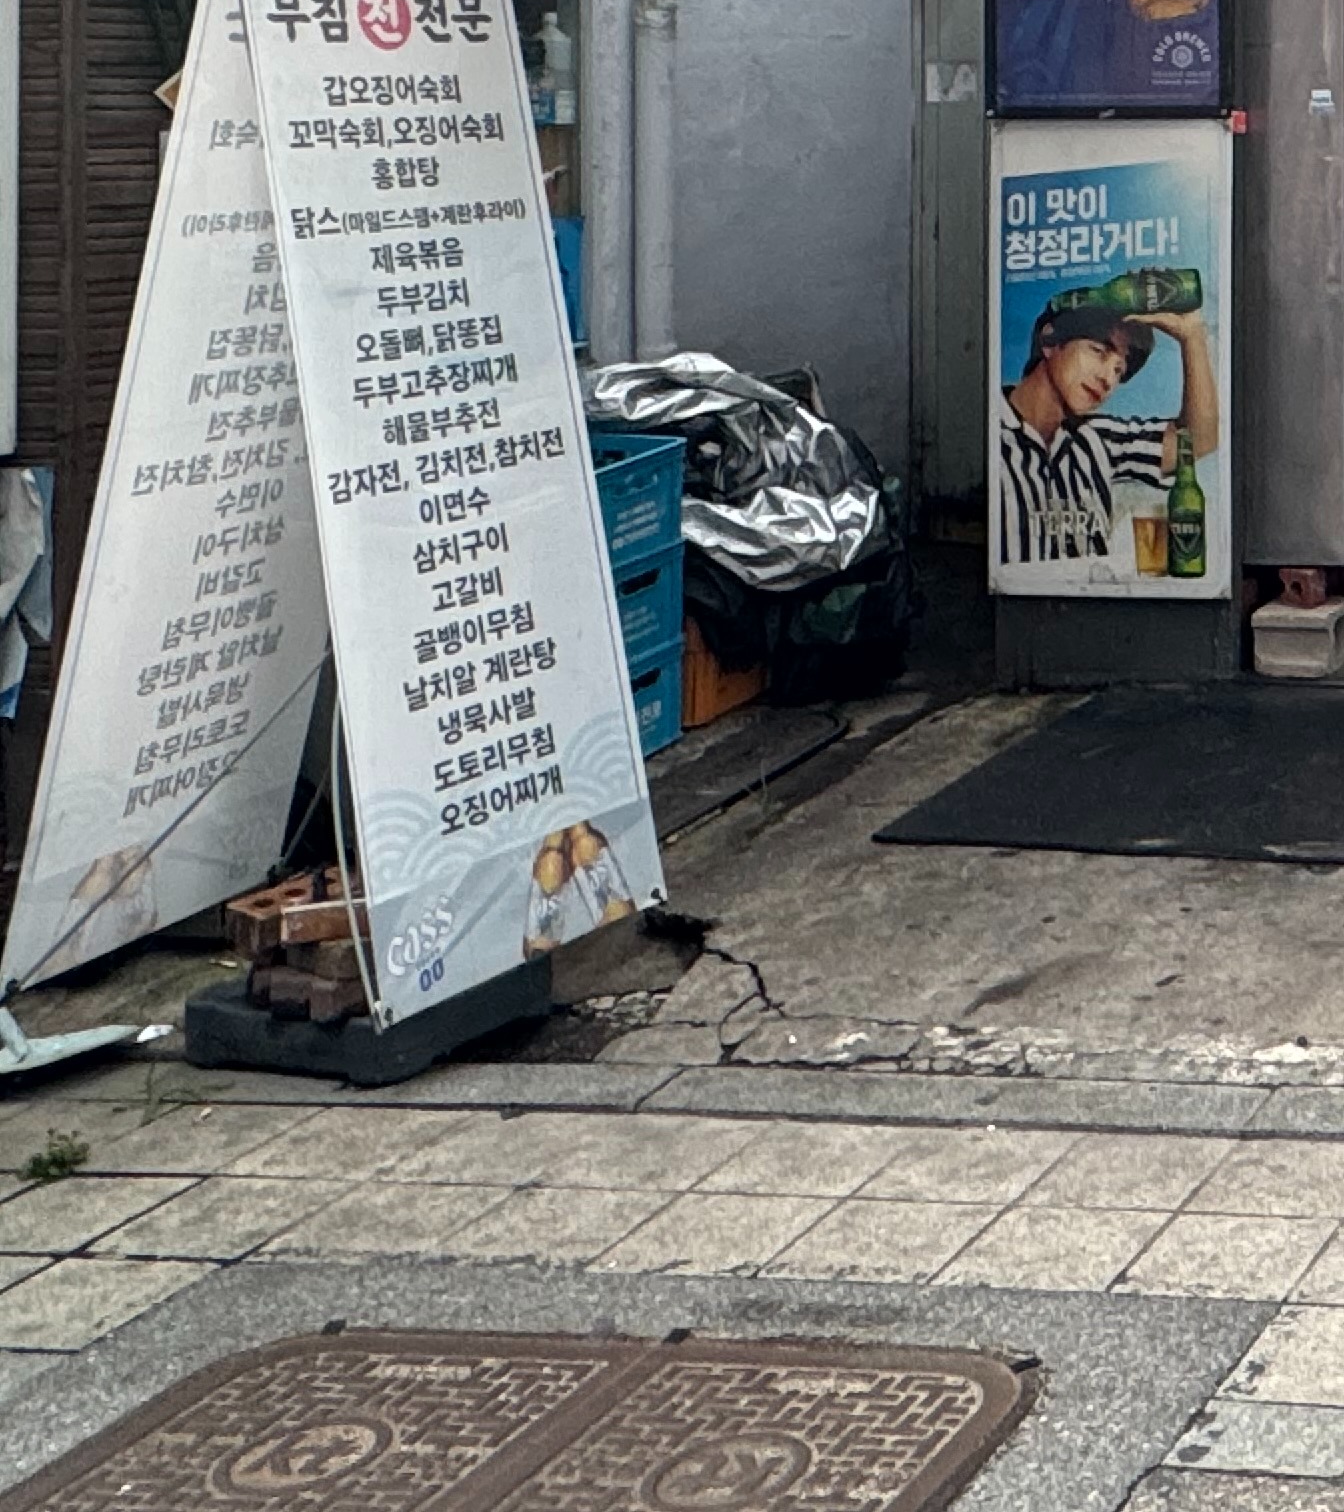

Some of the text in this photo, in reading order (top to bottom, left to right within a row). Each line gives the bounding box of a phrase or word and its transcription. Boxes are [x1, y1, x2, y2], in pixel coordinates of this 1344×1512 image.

[322, 74, 463, 107] 갑오징어숙회
[371, 157, 440, 190] 홍합탕
[1007, 184, 1108, 226] 이 맛이
[369, 237, 464, 275] 제육볶음
[1005, 216, 1180, 270] 청정라거다!
[377, 277, 470, 318] 두부김치
[353, 352, 519, 409] 두부고추장찌개
[382, 396, 501, 445] 해물부추전
[327, 459, 410, 505] 감자전,
[419, 486, 492, 525] 이면수
[412, 521, 510, 574] 삼치구이
[431, 565, 504, 612] 고갈비
[413, 600, 536, 665] 골뱅이무침
[402, 637, 558, 713] 날치알 계란탕
[437, 686, 537, 746] 냉묵사발
[433, 722, 556, 793] 도토리무침
[440, 763, 565, 836] 오징어찌개
